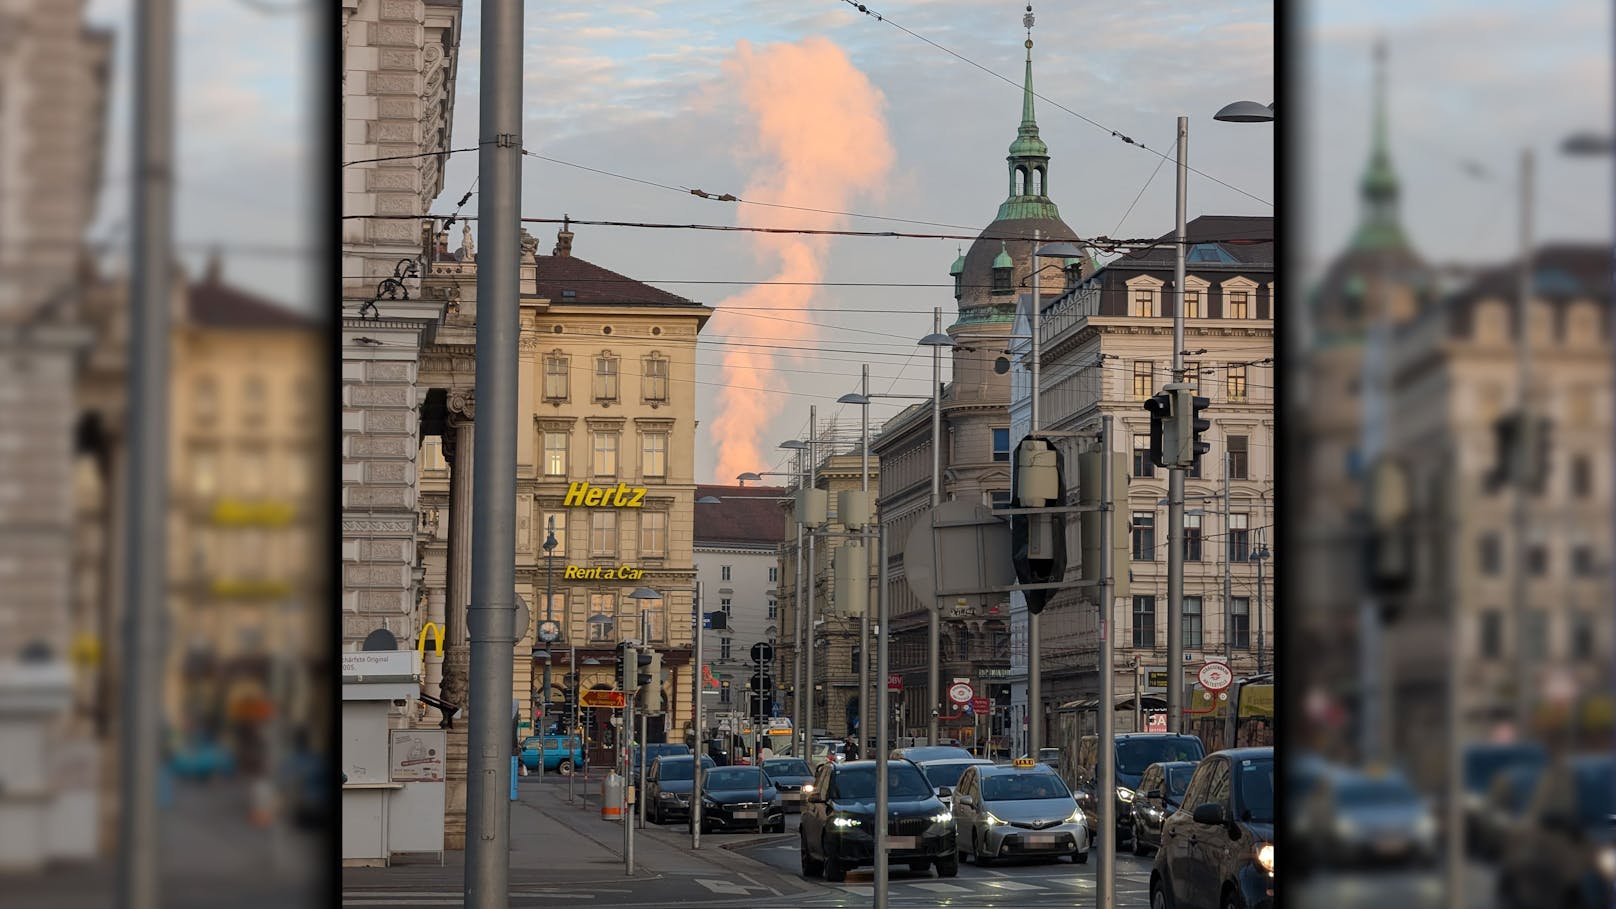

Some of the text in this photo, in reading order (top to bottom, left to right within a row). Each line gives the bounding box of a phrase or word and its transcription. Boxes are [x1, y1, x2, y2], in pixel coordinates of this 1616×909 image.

[563, 481, 648, 507] Hertz
[564, 565, 645, 579] Rent a Car
[366, 655, 389, 664] Original
